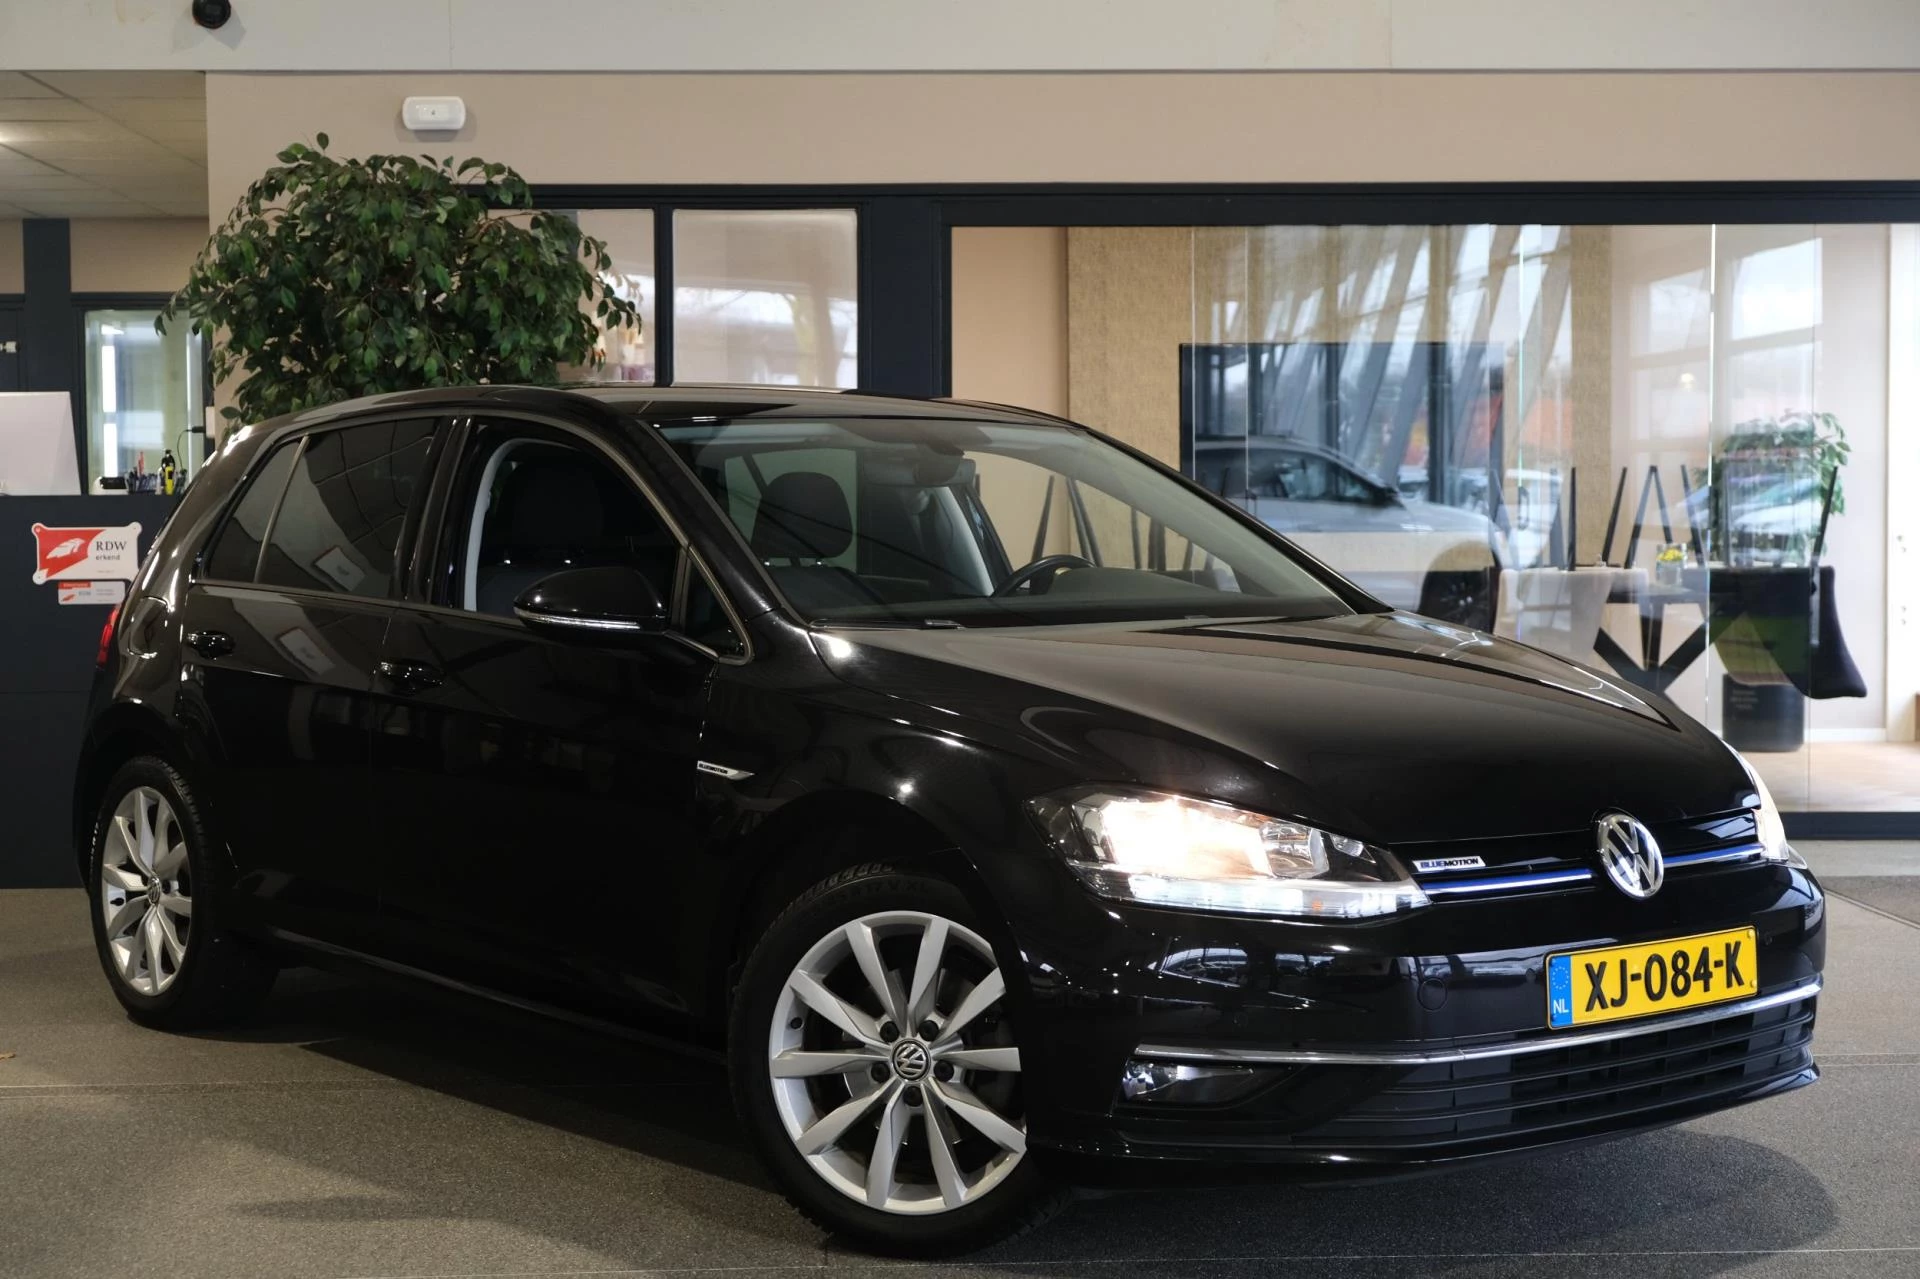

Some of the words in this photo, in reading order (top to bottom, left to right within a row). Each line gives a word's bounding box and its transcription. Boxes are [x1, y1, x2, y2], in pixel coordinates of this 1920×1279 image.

[97, 541, 125, 551] RDW
[1420, 858, 1479, 868] BLUEMOTION
[1585, 941, 1744, 1012] XJ-084-K
[1553, 998, 1569, 1014] NL
